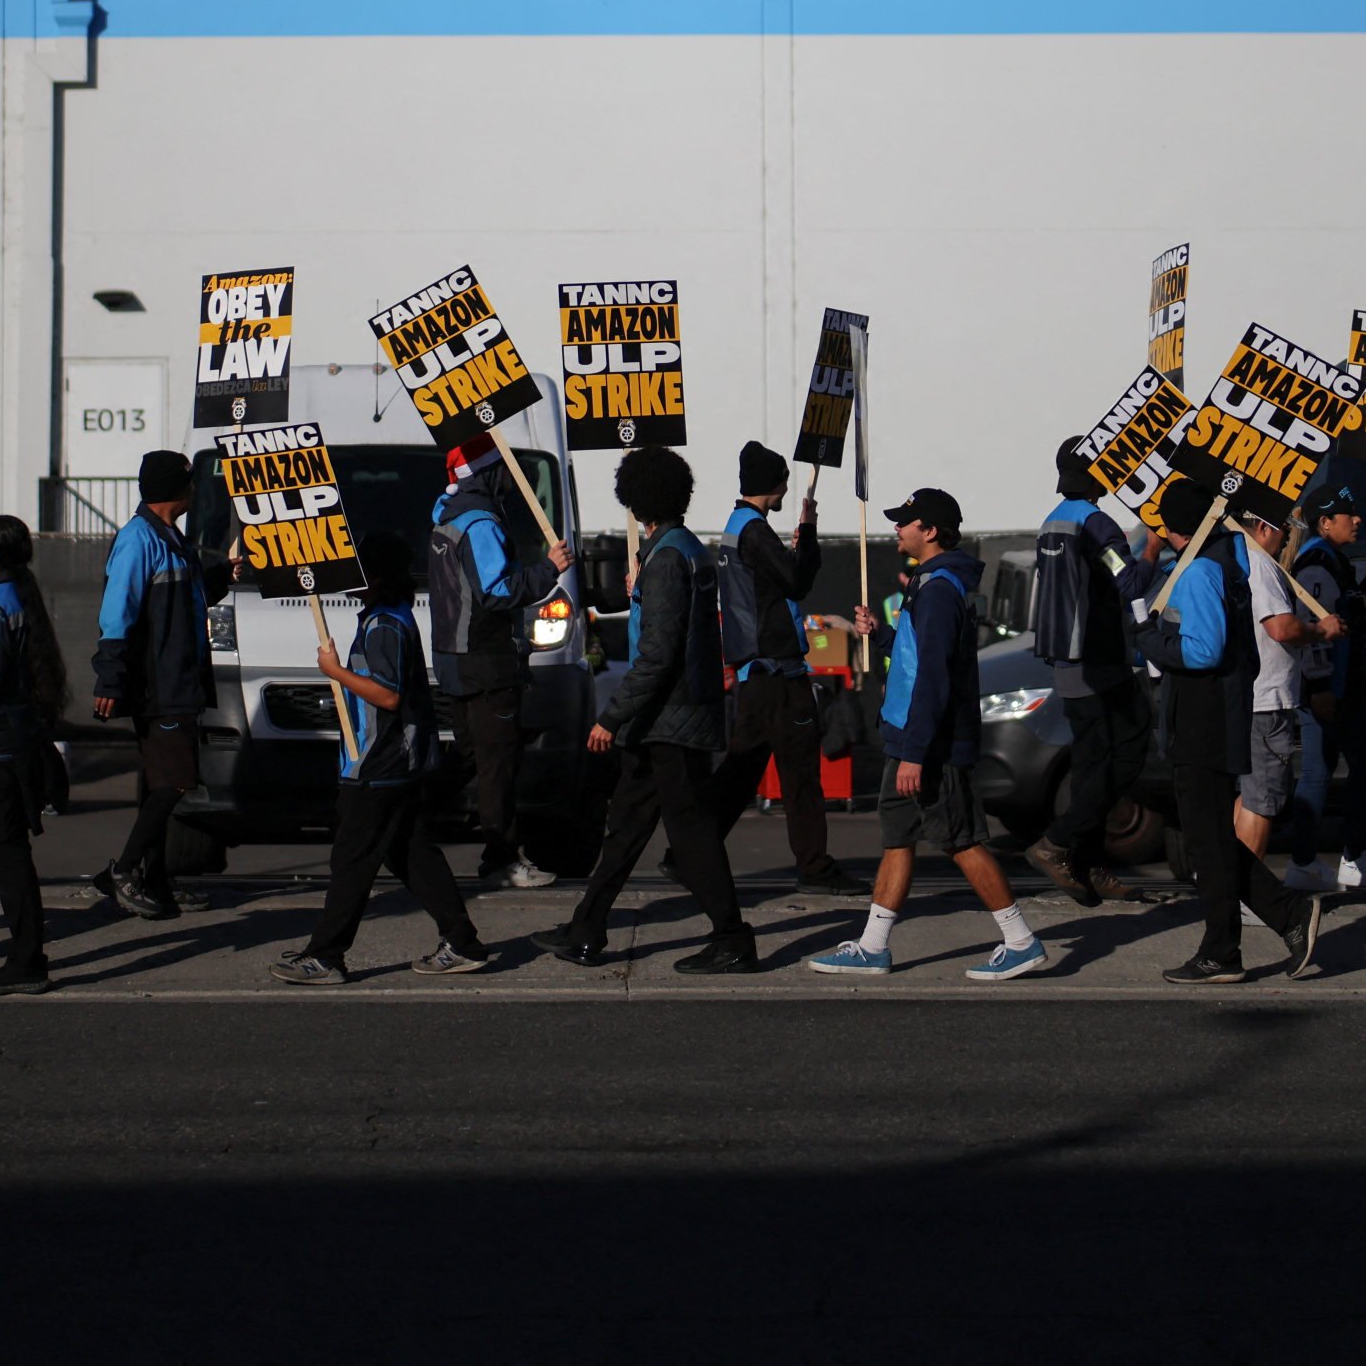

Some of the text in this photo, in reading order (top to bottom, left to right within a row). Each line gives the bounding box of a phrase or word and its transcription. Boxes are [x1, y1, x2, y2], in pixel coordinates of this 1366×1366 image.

[203, 273, 293, 294] Amazon:
[208, 282, 288, 324] OBEY
[372, 270, 471, 334] TANNC
[562, 282, 673, 307] TANNC
[219, 319, 271, 345] the
[388, 288, 490, 364] AMAZON
[567, 306, 675, 342] AMAZON
[1149, 301, 1185, 342] ULP
[198, 335, 291, 383] LAW
[397, 318, 502, 389] ULP
[563, 342, 680, 374] ULP
[1251, 326, 1359, 399] TANNC
[195, 379, 251, 397] OBEDEZCA
[268, 378, 288, 391] LEY
[413, 338, 529, 427] STRIKE
[565, 371, 683, 420] STRIKE
[1228, 351, 1349, 433] AMAZON
[83, 408, 145, 432] E013
[1075, 372, 1159, 461] TANNC
[1096, 386, 1187, 487] AMAZON
[1210, 377, 1331, 453] ULP
[219, 425, 318, 457] TANNC
[1187, 405, 1318, 502] STRIKE
[230, 449, 331, 493] AMAZON
[233, 485, 339, 524] ULP
[243, 514, 355, 570] STRIKE
